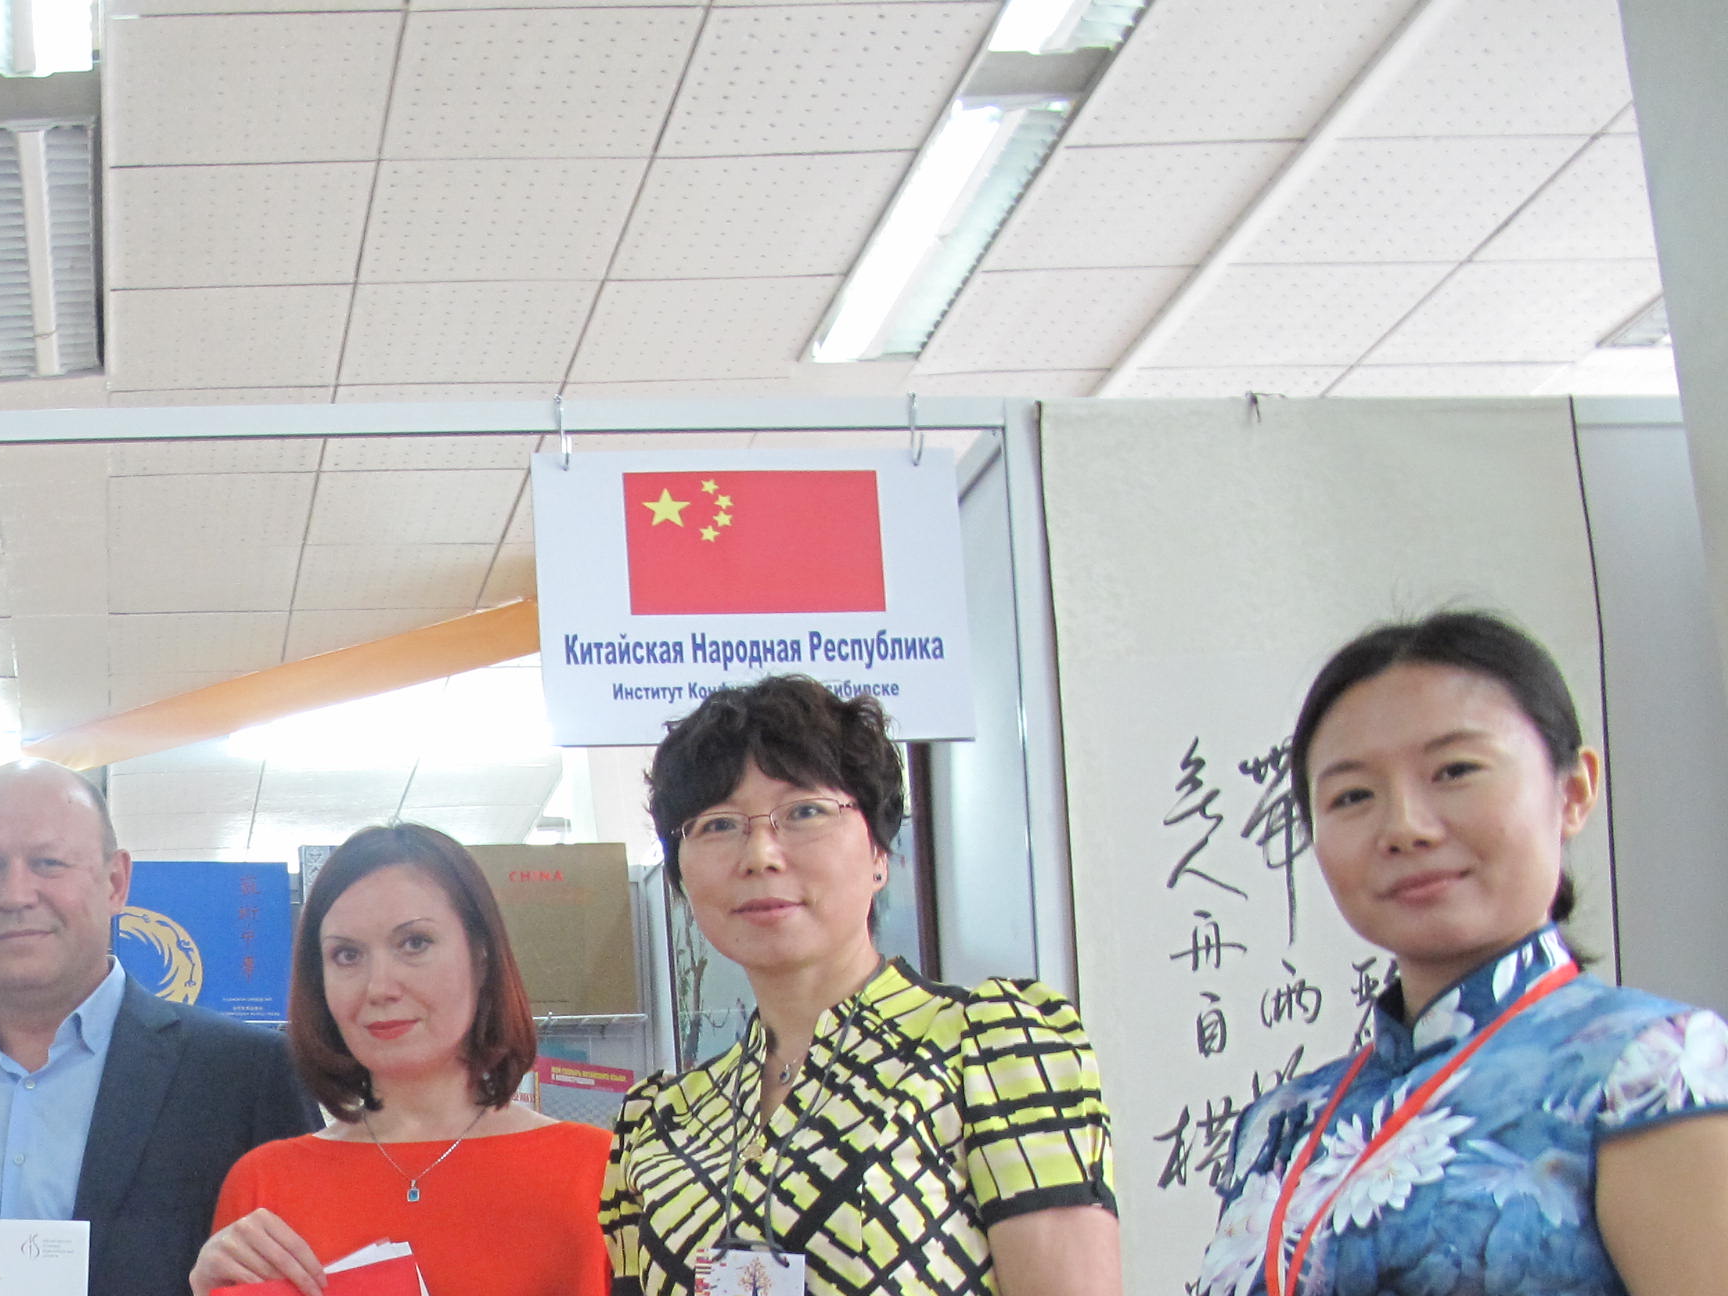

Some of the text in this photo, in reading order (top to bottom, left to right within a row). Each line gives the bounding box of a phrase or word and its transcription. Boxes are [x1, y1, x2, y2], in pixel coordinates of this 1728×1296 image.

[564, 629, 944, 670] Китайская Народная Республика
[612, 682, 683, 703] Институт
[508, 870, 565, 882] CHINA
